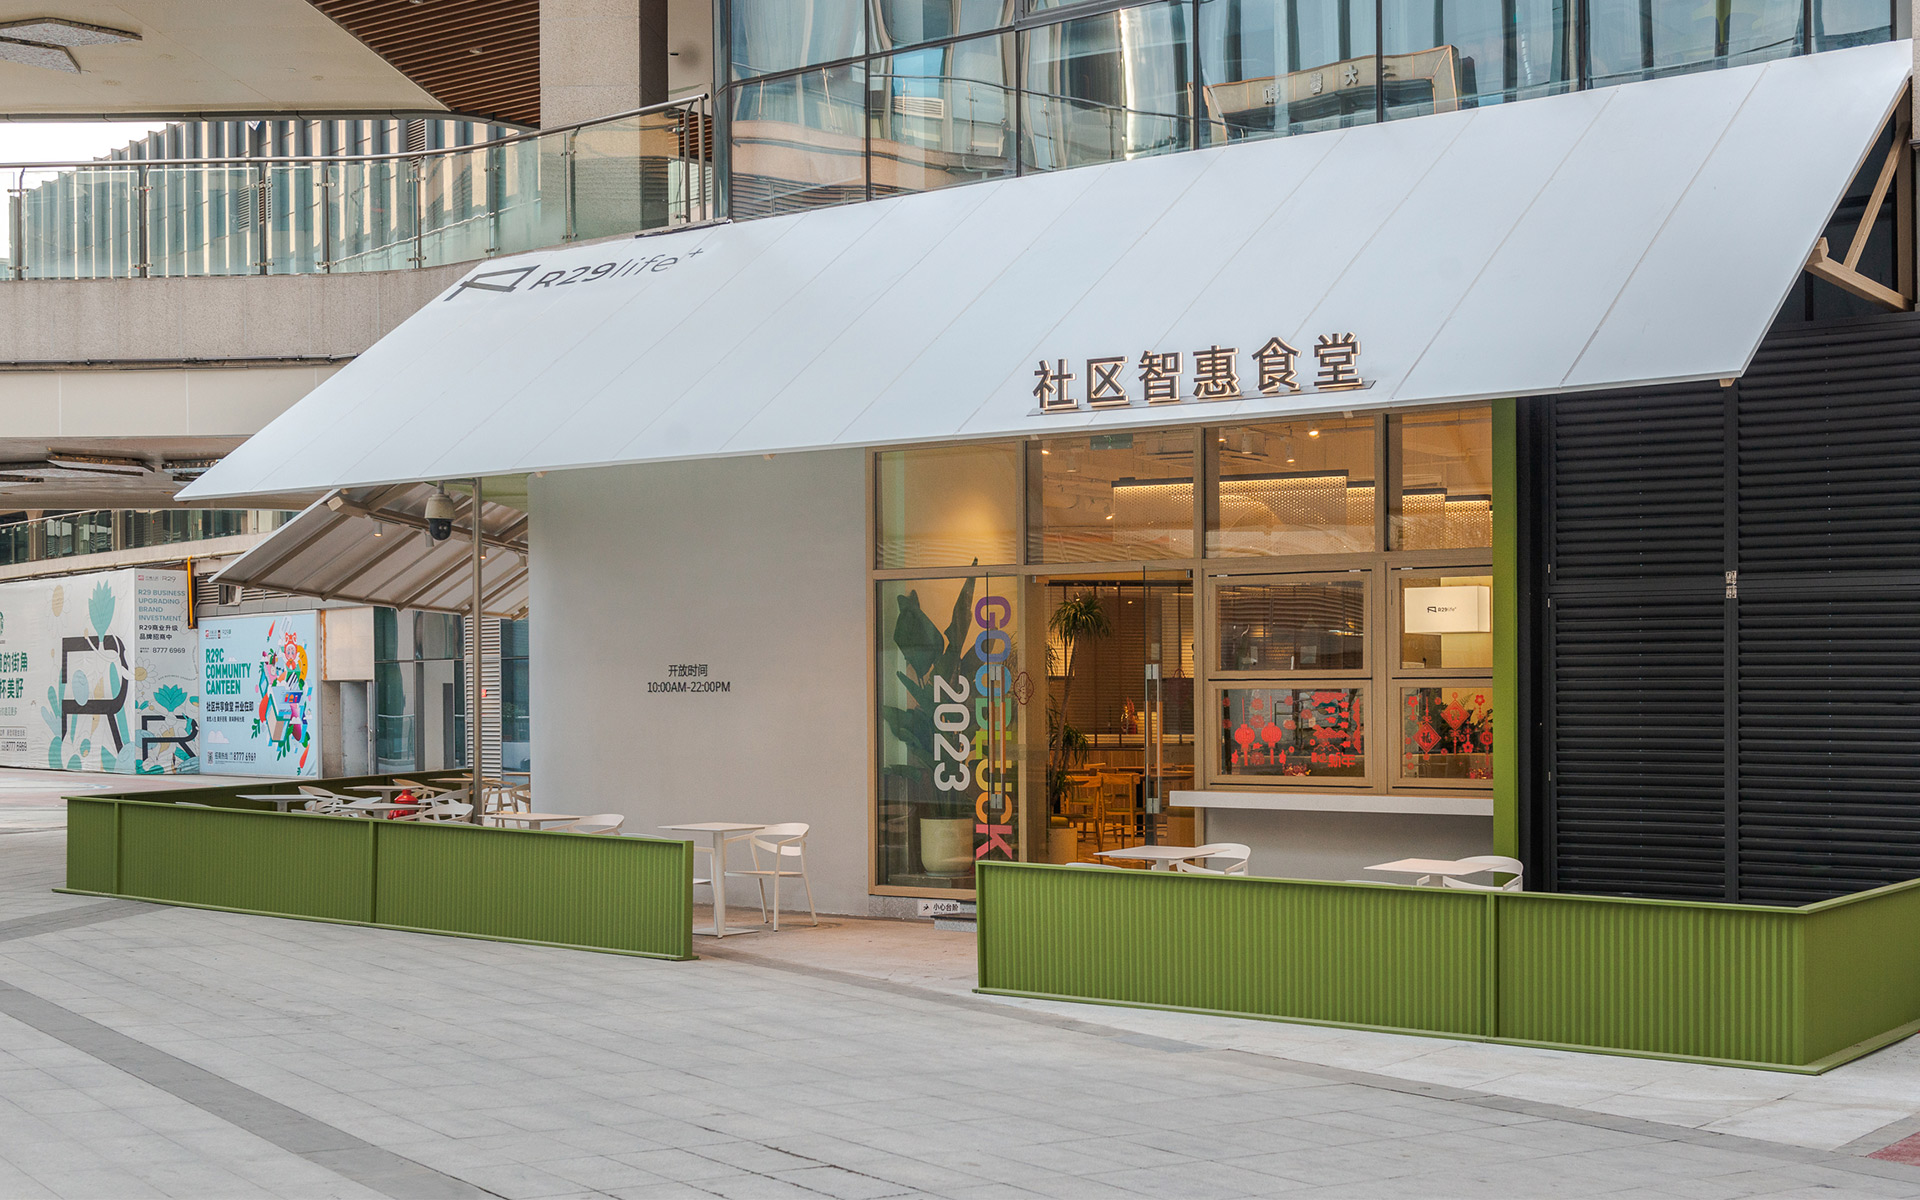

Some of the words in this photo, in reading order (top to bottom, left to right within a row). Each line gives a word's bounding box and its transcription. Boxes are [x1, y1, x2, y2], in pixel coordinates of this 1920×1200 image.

[1033, 332, 1364, 409] 社区智惠食堂
[206, 648, 224, 663] R29C
[206, 663, 251, 679] COMMUNITY
[668, 664, 708, 677] 开放时间
[206, 680, 240, 695] CANTEEN
[647, 681, 731, 693] 10:00AM-22:00PM
[933, 675, 970, 792] 2023
[933, 903, 959, 911] 小心台阶
